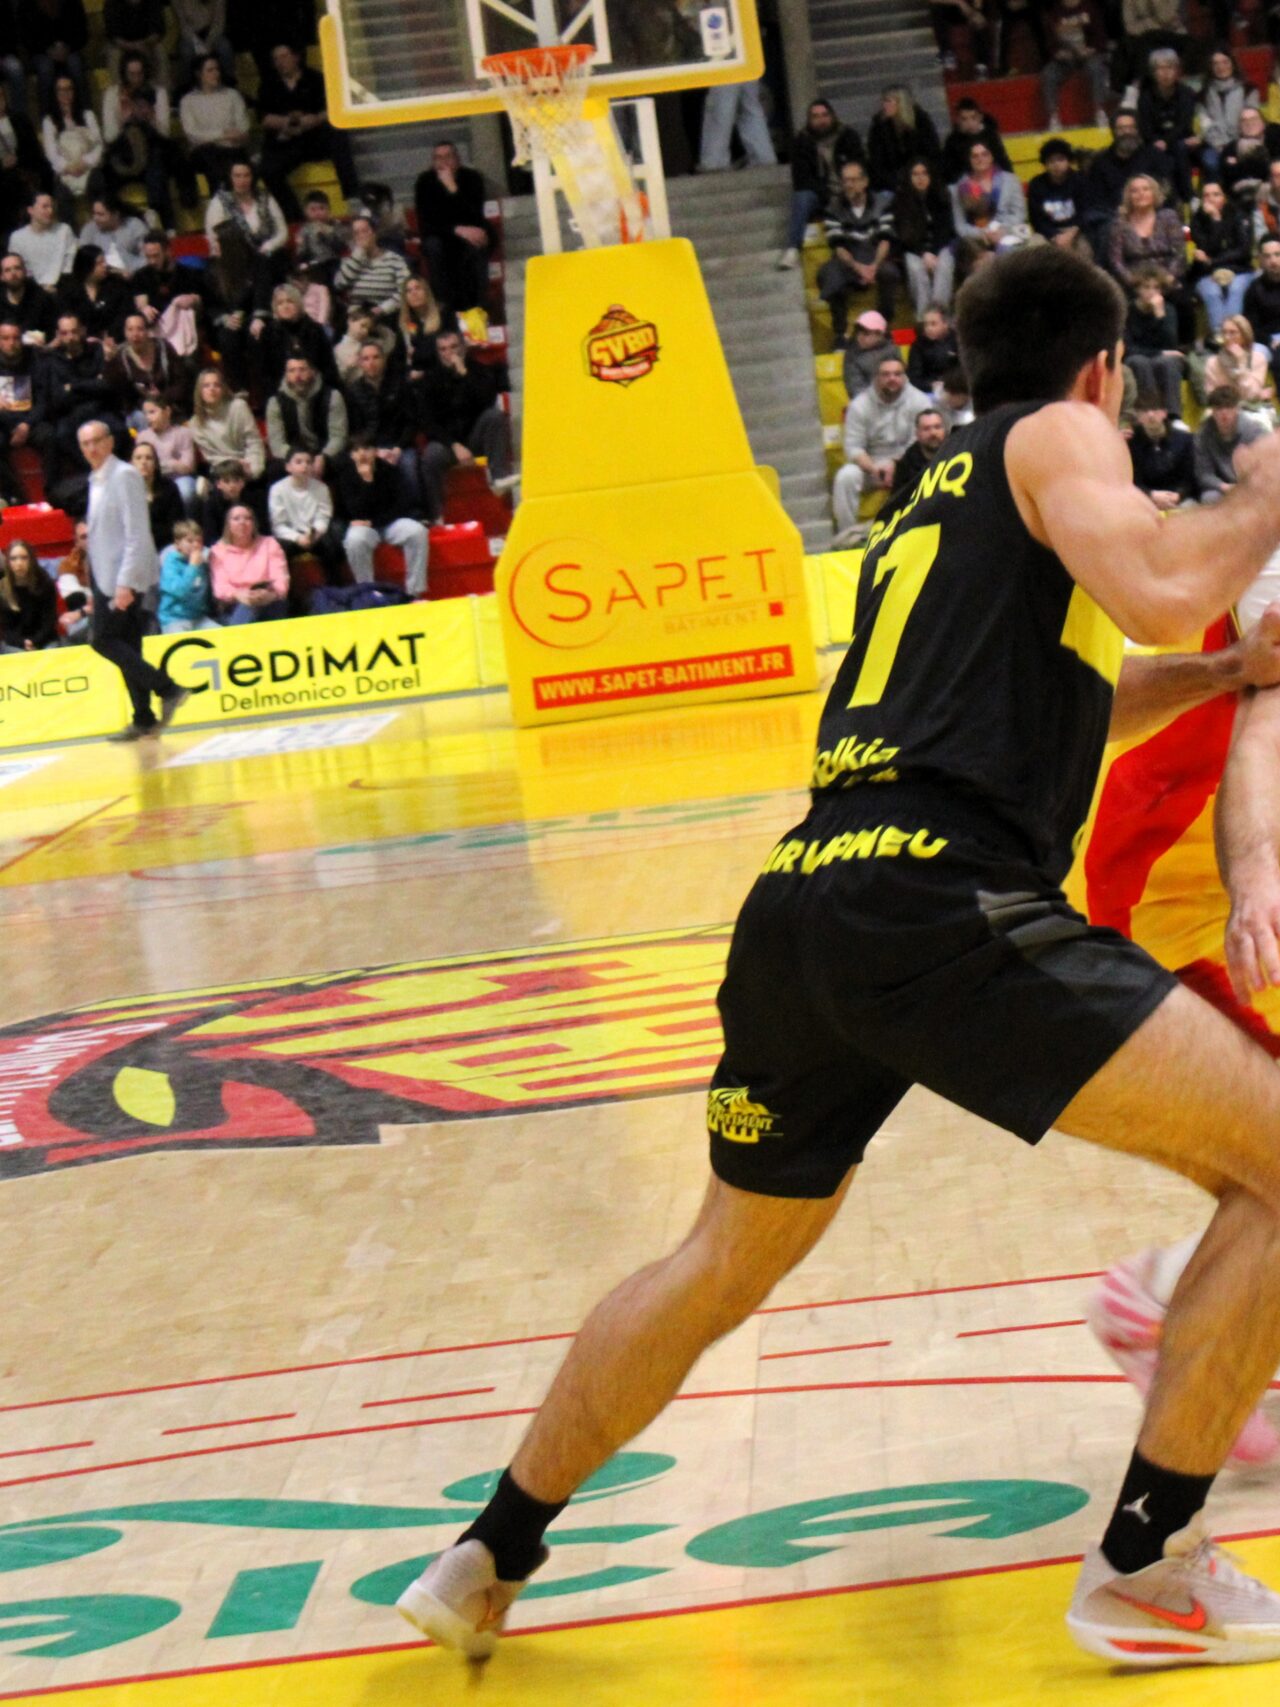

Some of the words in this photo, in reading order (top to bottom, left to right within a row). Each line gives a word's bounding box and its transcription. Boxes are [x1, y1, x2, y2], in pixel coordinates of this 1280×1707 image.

[544, 548, 776, 623] SAPET
[846, 523, 942, 709] 7
[0, 676, 89, 702] NICO
[220, 676, 347, 713] Delmonico
[356, 668, 422, 695] Dorel
[537, 652, 785, 701] WWW.SAPET-BATIMENT.FR
[808, 734, 901, 789] alkia
